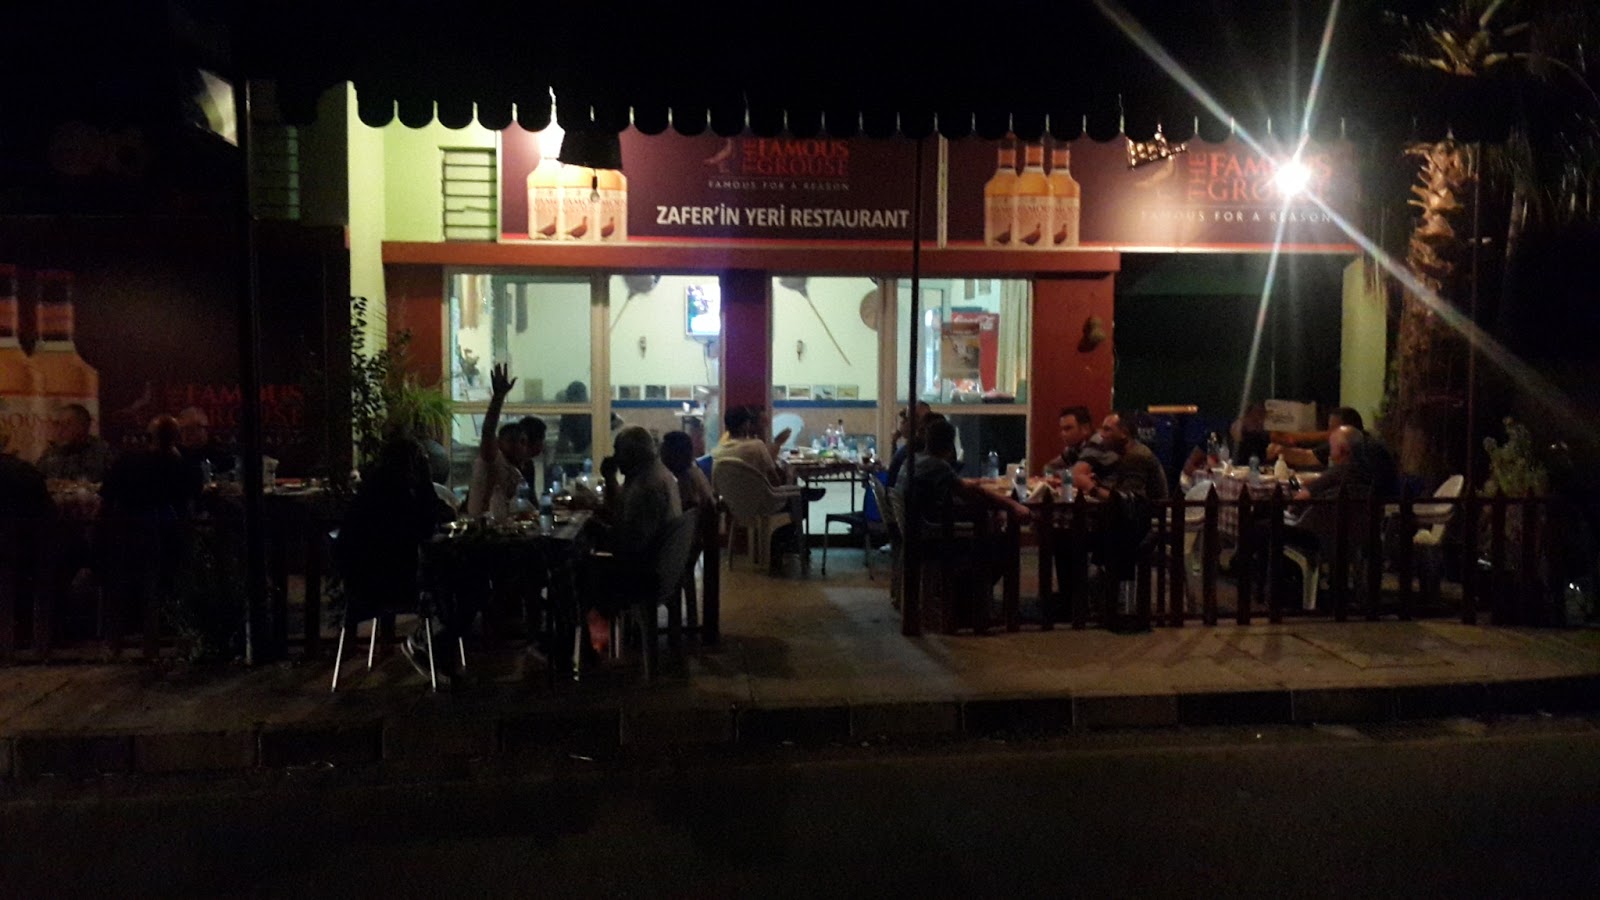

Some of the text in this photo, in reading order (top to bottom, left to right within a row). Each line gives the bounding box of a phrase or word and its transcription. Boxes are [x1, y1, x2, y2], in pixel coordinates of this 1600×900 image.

[757, 139, 850, 158] FAMOUS
[757, 158, 847, 176] GROUSE
[1208, 152, 1332, 177] FAMS
[708, 180, 850, 191] FAMOUS FOR A REASON
[745, 204, 786, 227] YERİ
[790, 208, 910, 229] RESTAURANT
[1213, 210, 1244, 222] FOR
[1252, 211, 1261, 222] A
